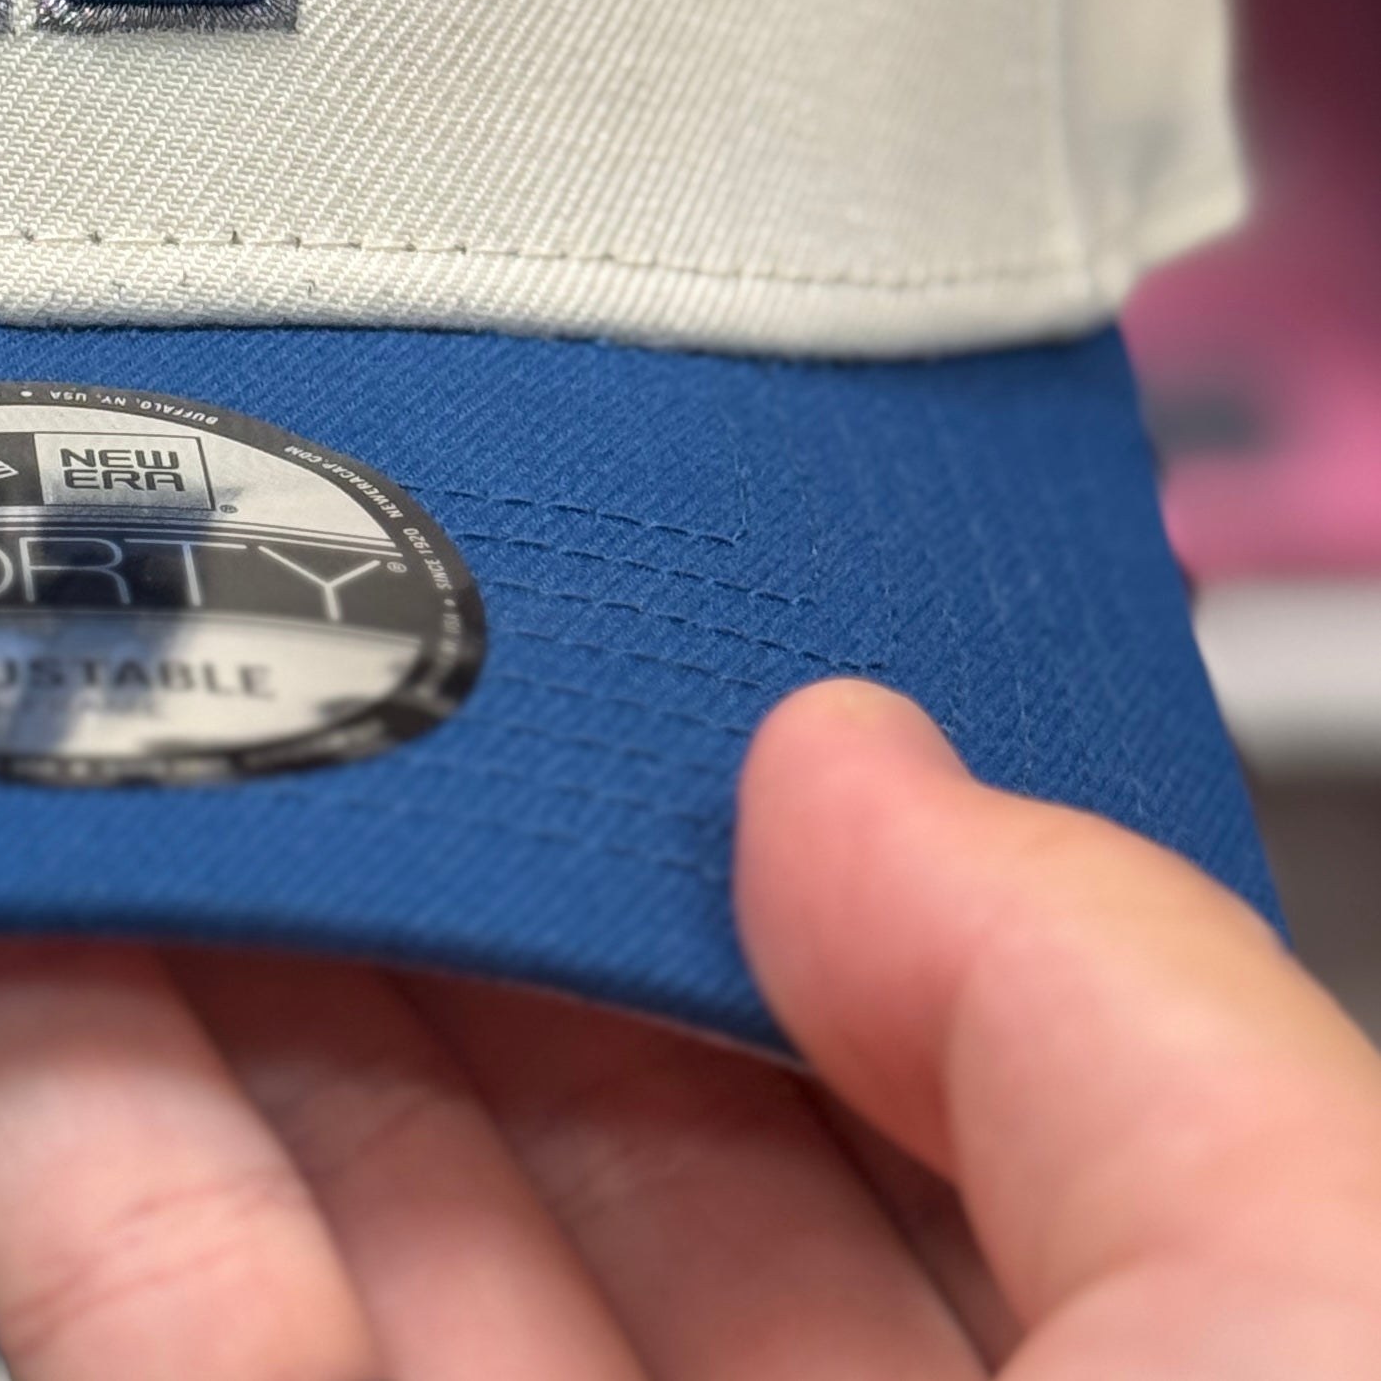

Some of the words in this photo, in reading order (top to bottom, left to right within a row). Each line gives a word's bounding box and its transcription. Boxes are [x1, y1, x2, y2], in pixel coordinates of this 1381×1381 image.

[49, 389, 87, 402] USA
[59, 447, 180, 469] NEW
[64, 469, 187, 492] ERA
[284, 445, 404, 519] NEWERACAP.COM
[402, 527, 434, 555] 1920
[424, 556, 454, 591] SINCE
